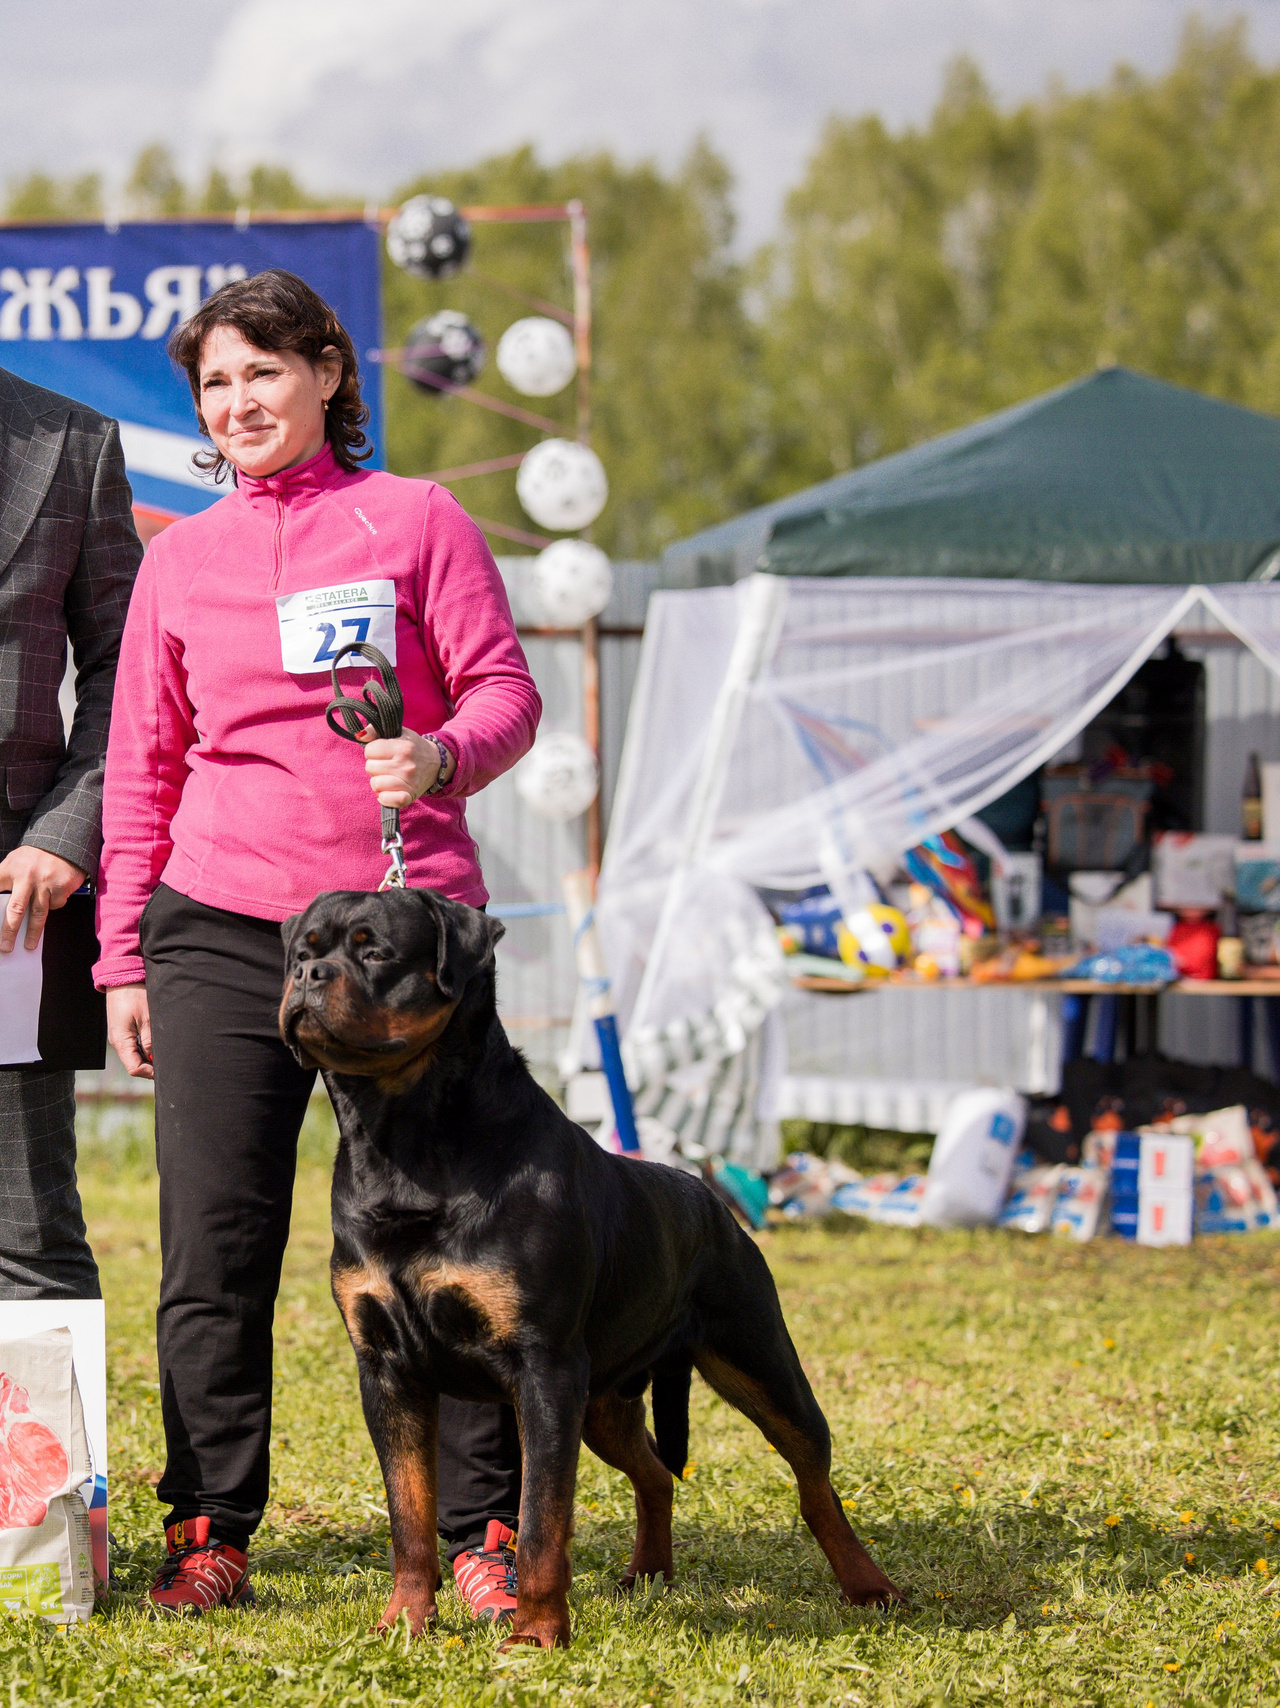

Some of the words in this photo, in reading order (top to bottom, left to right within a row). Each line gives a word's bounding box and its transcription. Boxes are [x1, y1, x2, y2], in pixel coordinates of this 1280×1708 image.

[310, 617, 371, 663] 27
[2, 1572, 23, 1580] КОРМ
[40, 1601, 48, 1610] 3
